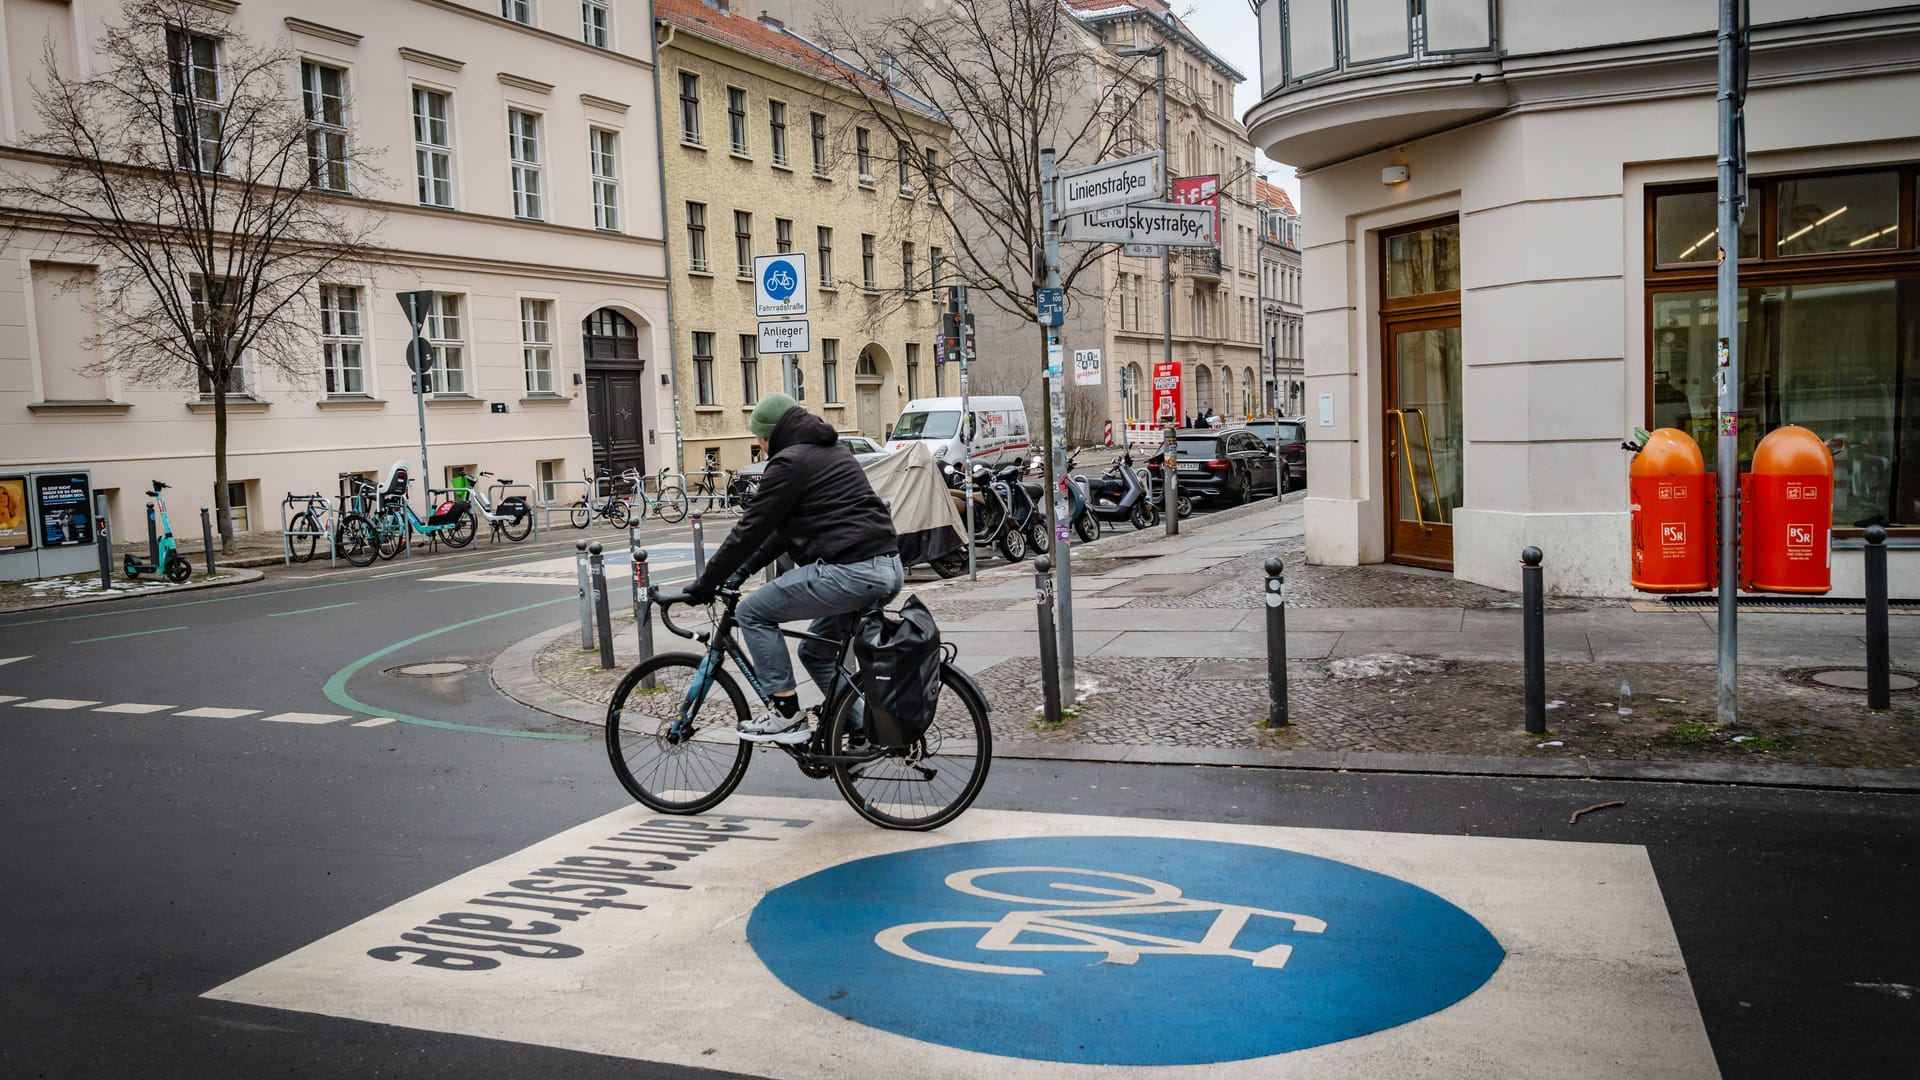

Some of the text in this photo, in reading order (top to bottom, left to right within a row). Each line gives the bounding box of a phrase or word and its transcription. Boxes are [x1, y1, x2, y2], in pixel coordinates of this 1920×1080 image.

[1069, 171, 1137, 201] Linienstraße
[1039, 294, 1045, 302] S
[758, 302, 804, 312] Fahrradstraße
[764, 326, 802, 337] Anlieger
[776, 338, 792, 348] frei
[1664, 527, 1683, 541] BSR
[1790, 528, 1810, 542] BSR
[366, 813, 815, 971] Fahrradstraße
